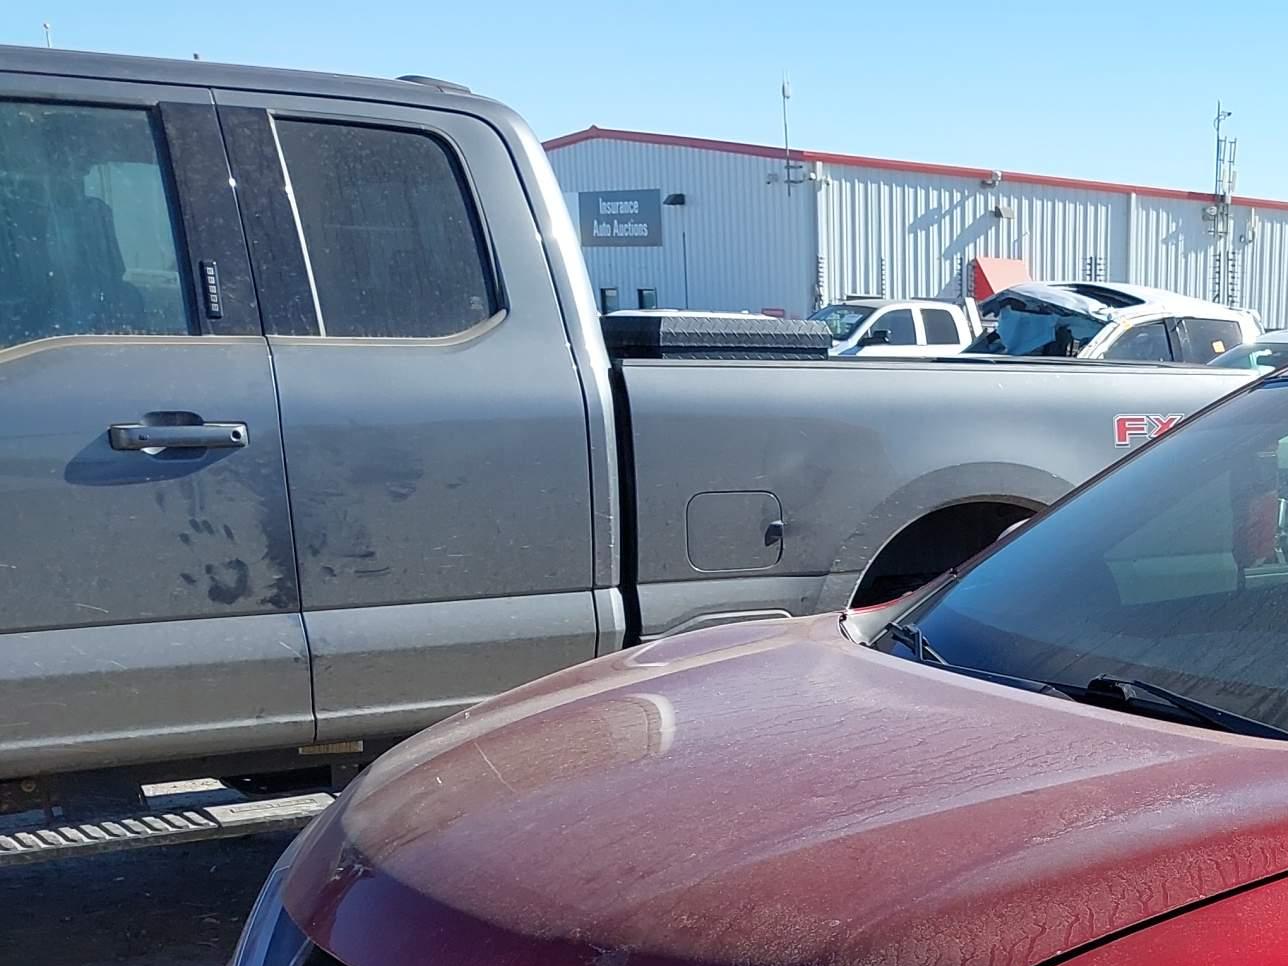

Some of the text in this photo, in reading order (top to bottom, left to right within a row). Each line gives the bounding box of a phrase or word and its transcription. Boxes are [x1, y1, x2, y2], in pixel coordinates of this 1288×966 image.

[599, 197, 639, 215] Insurance
[593, 219, 648, 237] Auto Auctions
